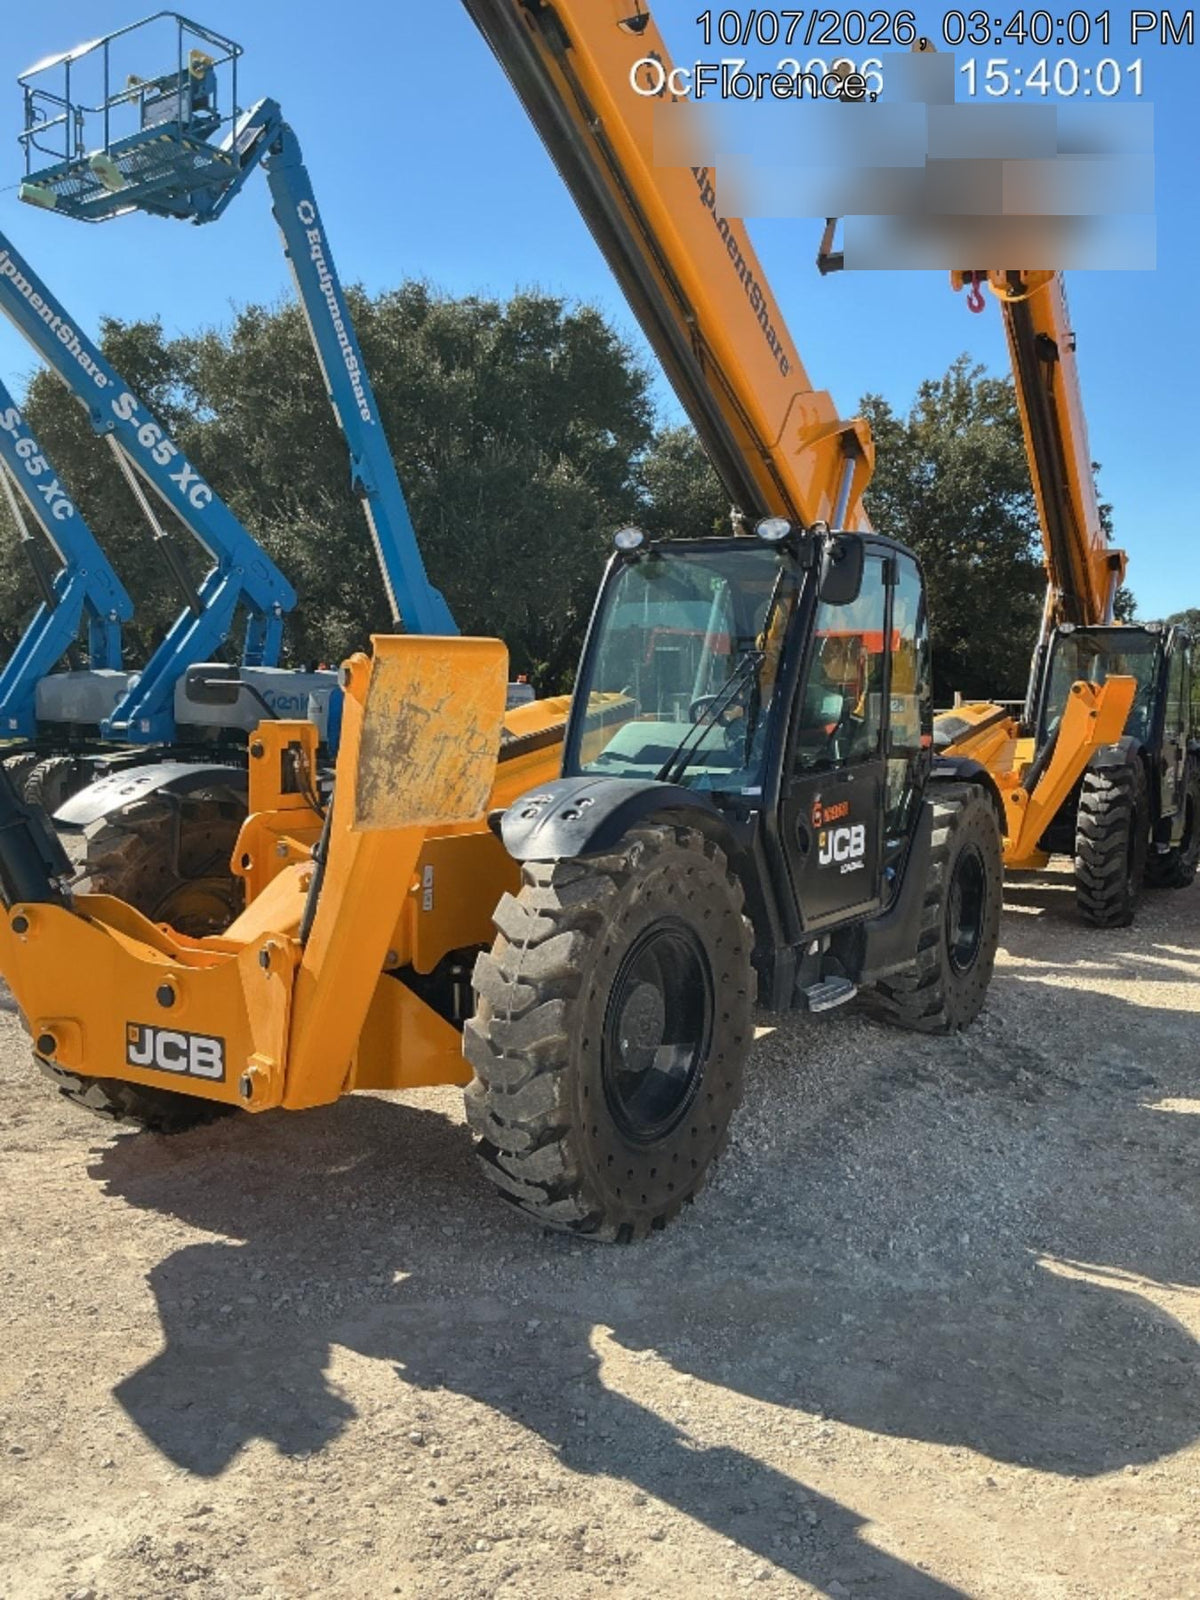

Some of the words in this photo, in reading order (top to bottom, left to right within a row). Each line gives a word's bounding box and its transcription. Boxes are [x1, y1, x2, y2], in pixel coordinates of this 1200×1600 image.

[306, 228, 371, 423] EquipmentShare
[0, 408, 50, 476] S-65
[37, 479, 74, 520] XC
[111, 392, 178, 466] S-65
[169, 462, 213, 509] XC
[263, 690, 309, 711] Geni
[818, 825, 866, 866] JCB
[128, 1026, 224, 1079] JCB
